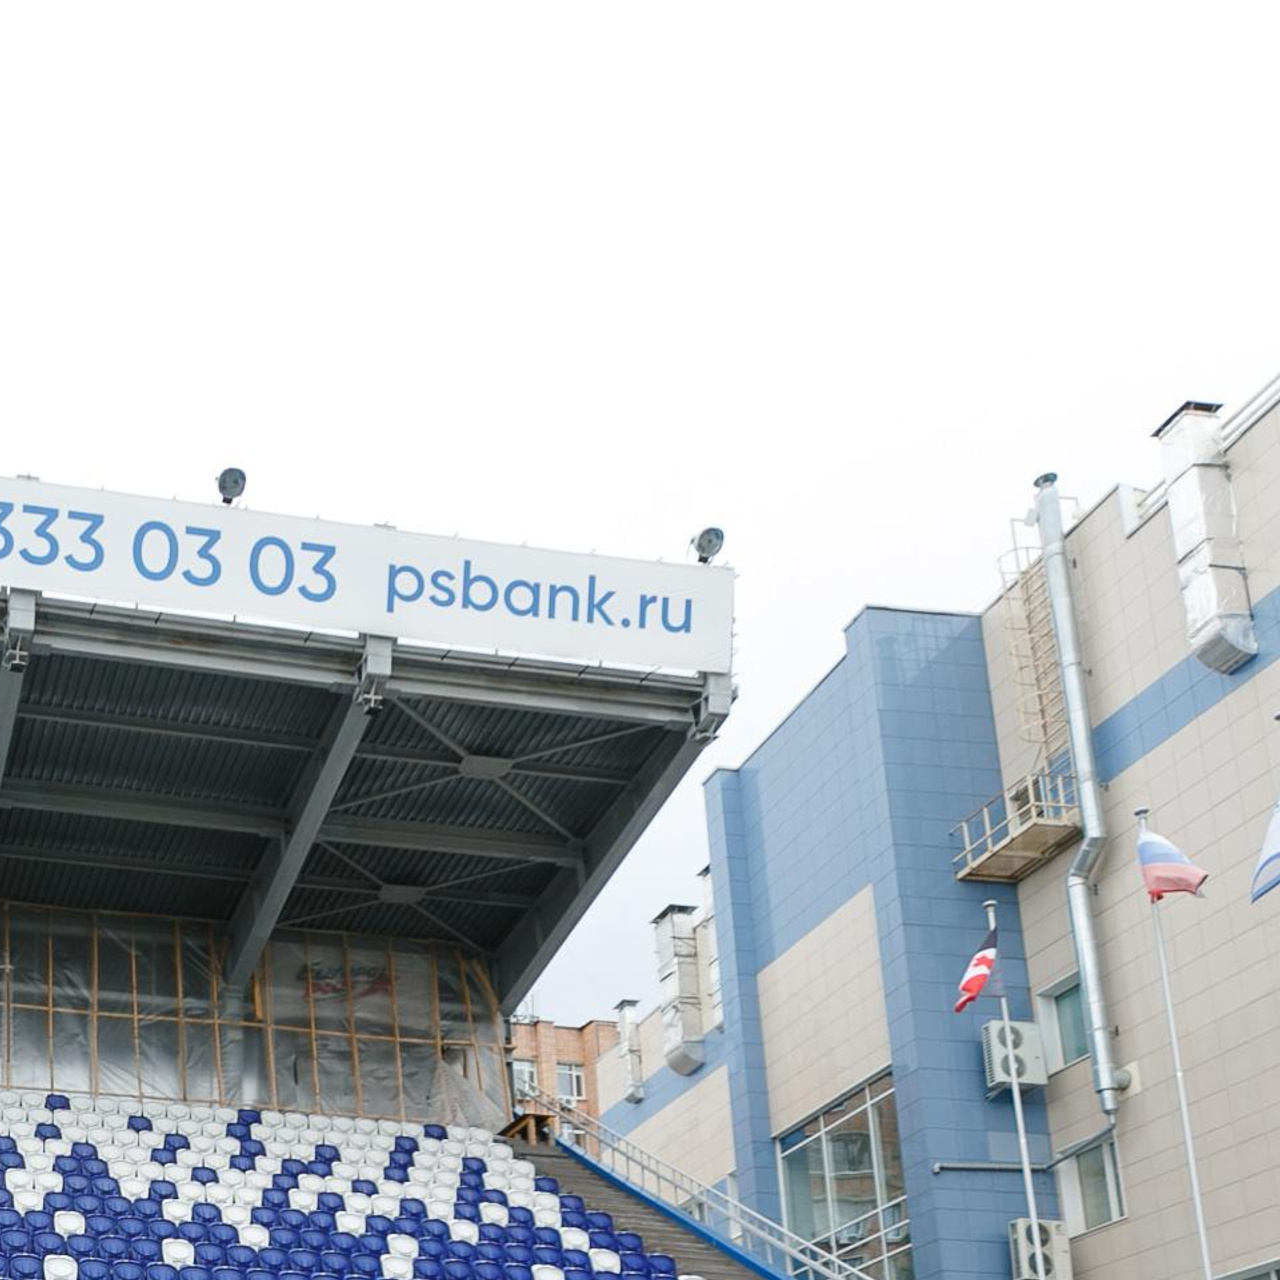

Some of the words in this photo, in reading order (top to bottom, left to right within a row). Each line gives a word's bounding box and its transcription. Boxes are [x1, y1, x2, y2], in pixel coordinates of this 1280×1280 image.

[131, 519, 223, 587] 03
[248, 535, 338, 604] 03
[385, 559, 693, 635] psbank.ru
